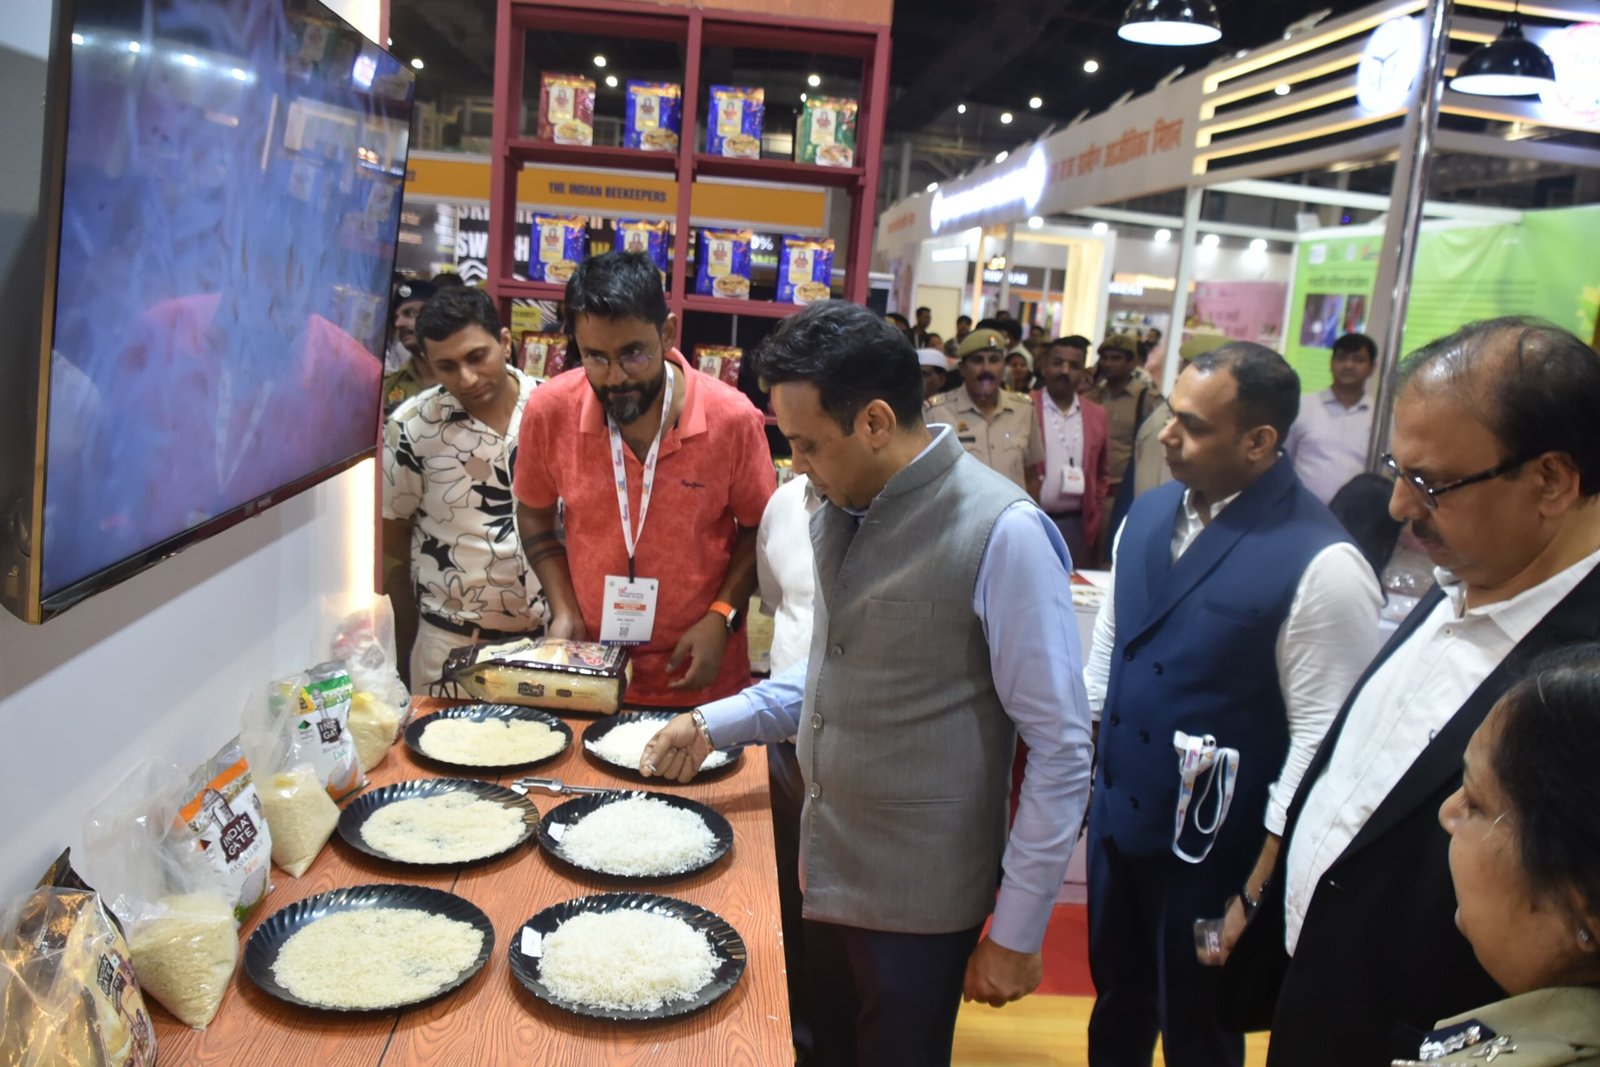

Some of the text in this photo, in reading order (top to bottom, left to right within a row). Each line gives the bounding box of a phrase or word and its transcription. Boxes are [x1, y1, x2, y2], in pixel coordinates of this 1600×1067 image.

[549, 182, 667, 203] THE INDIAN BEEKEEPERS
[223, 818, 250, 848] INDIA
[228, 826, 255, 856] GATE
